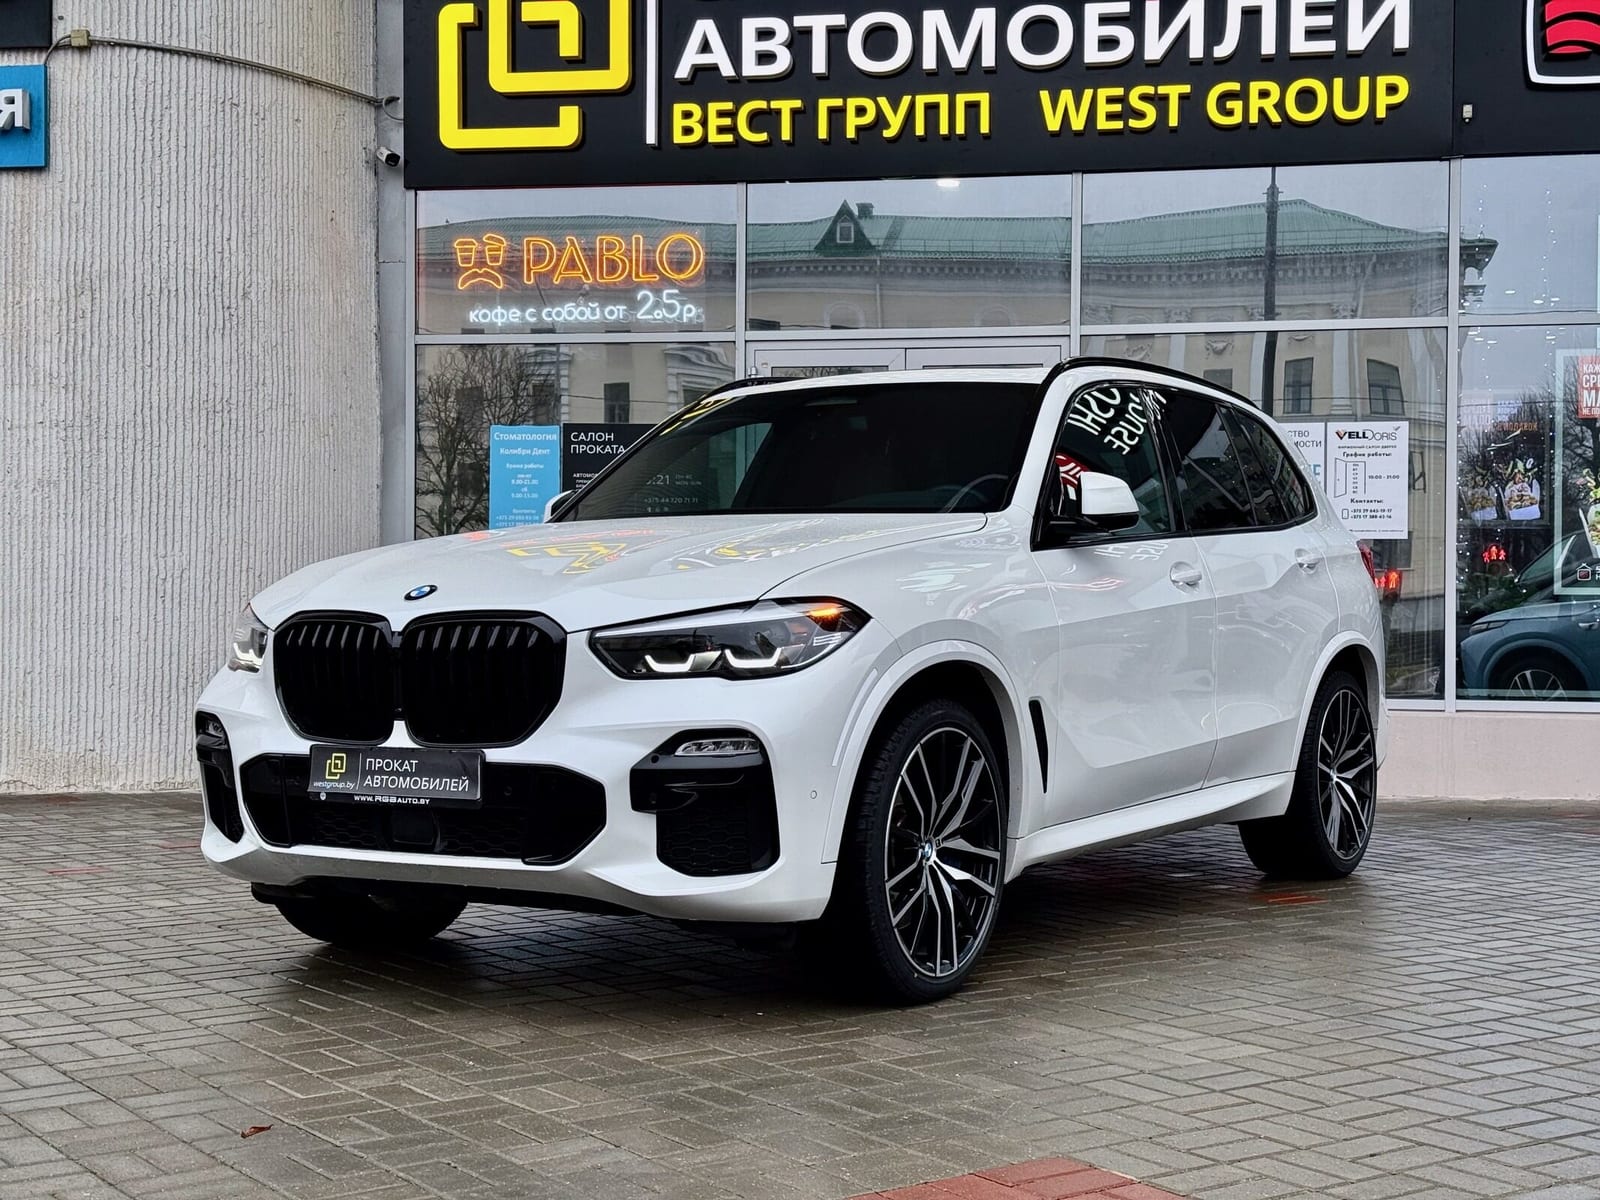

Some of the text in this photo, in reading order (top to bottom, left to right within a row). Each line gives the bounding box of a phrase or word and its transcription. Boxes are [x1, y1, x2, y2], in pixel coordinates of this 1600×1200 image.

[1040, 75, 1409, 131] WEST GROUP
[673, 93, 990, 144] ВЕСТ ГРУПП
[523, 233, 704, 285] PABLO
[469, 305, 521, 326] кофе
[525, 308, 537, 322] с
[542, 302, 600, 323] собой
[605, 305, 628, 321] от
[494, 431, 557, 441] Стоматология
[570, 432, 614, 442] САЛОН
[570, 444, 625, 454] ПРОКАТА
[365, 758, 419, 773] ПРОКАТ
[313, 781, 356, 791] westgroup.by
[363, 775, 470, 792] АВТОМОБИЛЕЙ
